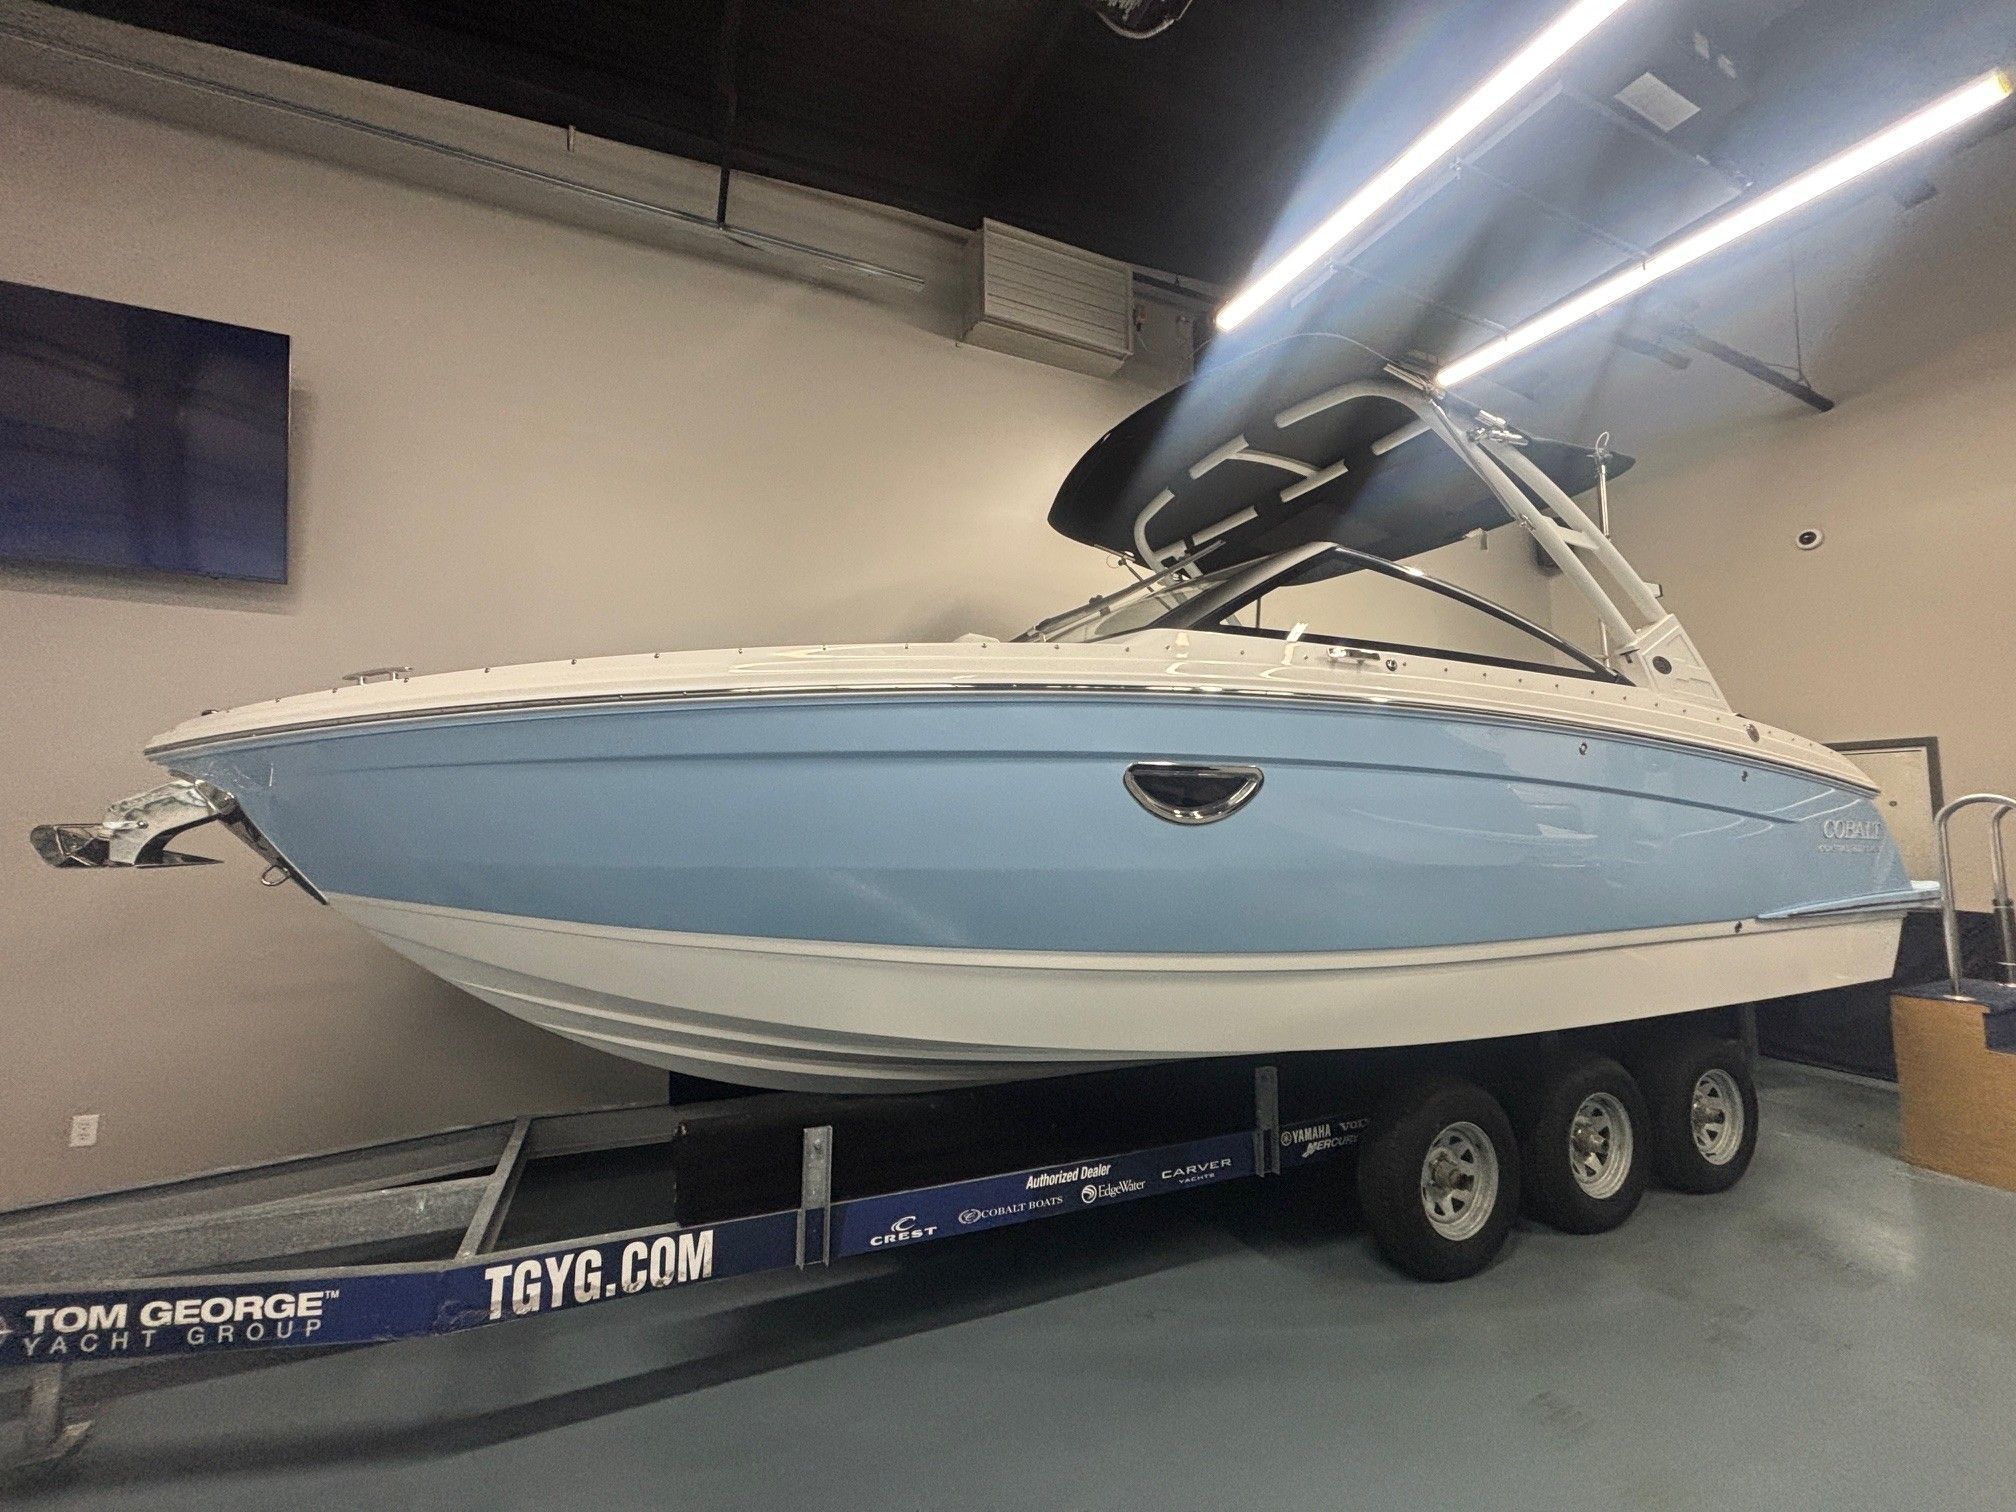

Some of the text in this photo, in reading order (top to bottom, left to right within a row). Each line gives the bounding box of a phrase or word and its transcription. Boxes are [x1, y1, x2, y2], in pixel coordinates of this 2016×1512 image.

[1823, 820, 1881, 839] COBALT
[1292, 1124, 1331, 1143] YAMAHA
[1026, 1163, 1111, 1189] Authorized Dealer
[1162, 1158, 1232, 1179] CARVER
[1179, 1173, 1215, 1184] YACHTS
[1098, 1179, 1146, 1198] EdgeWater
[981, 1195, 1063, 1218] COBALT BOATS
[870, 1226, 938, 1246] CREST
[484, 1230, 714, 1320] TGYG.COM
[25, 1303, 128, 1335] TOM
[22, 1318, 323, 1357] YACHT GROUP
